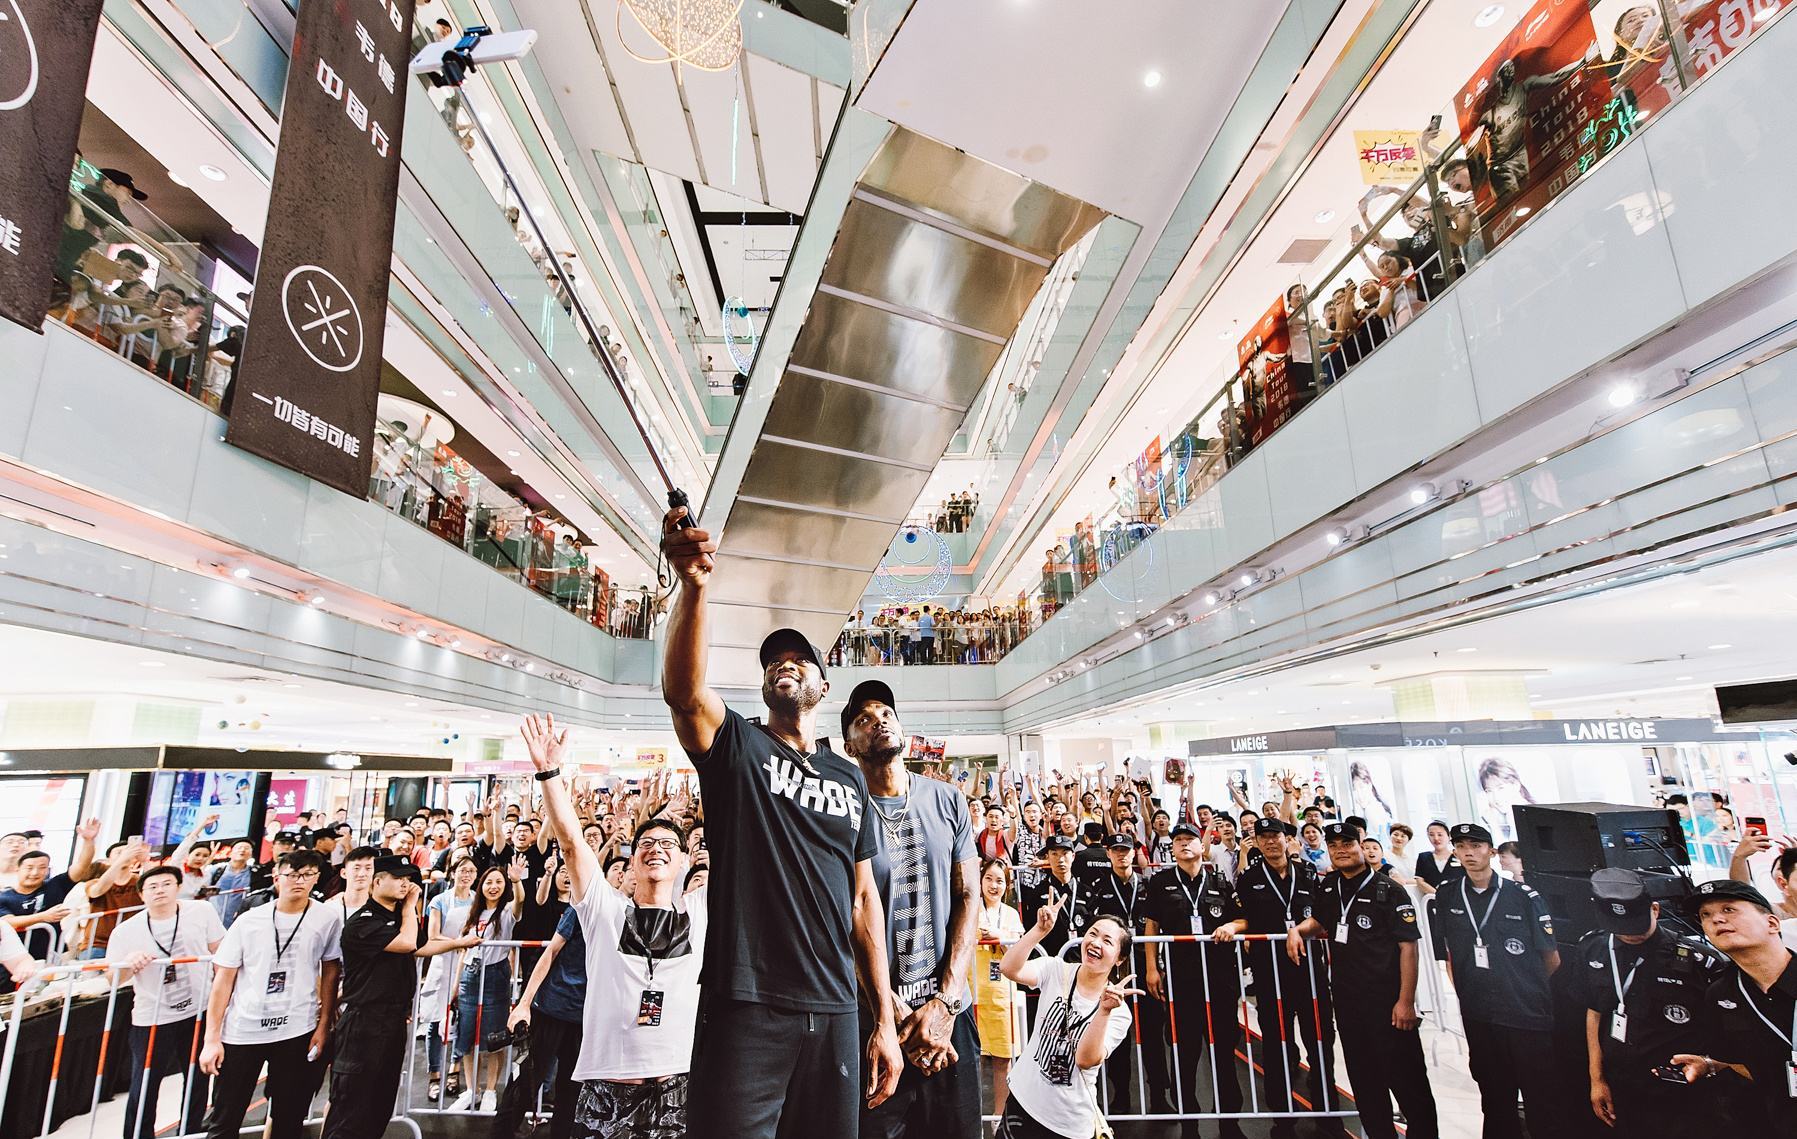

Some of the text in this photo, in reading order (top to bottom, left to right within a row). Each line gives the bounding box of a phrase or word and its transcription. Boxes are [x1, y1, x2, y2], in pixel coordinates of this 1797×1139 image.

[355, 19, 396, 95] 韦德
[316, 57, 390, 158] 中国行
[1529, 74, 1582, 129] China
[1542, 91, 1584, 133] Tour
[1540, 105, 1588, 157] 2018
[251, 391, 361, 459] 一切皆有可能
[1231, 735, 1269, 752] LANEIGE
[1563, 721, 1658, 741] LANEIGE
[762, 754, 862, 818] WADE
[898, 977, 939, 1002] WADE
[260, 1015, 288, 1027] WADE
